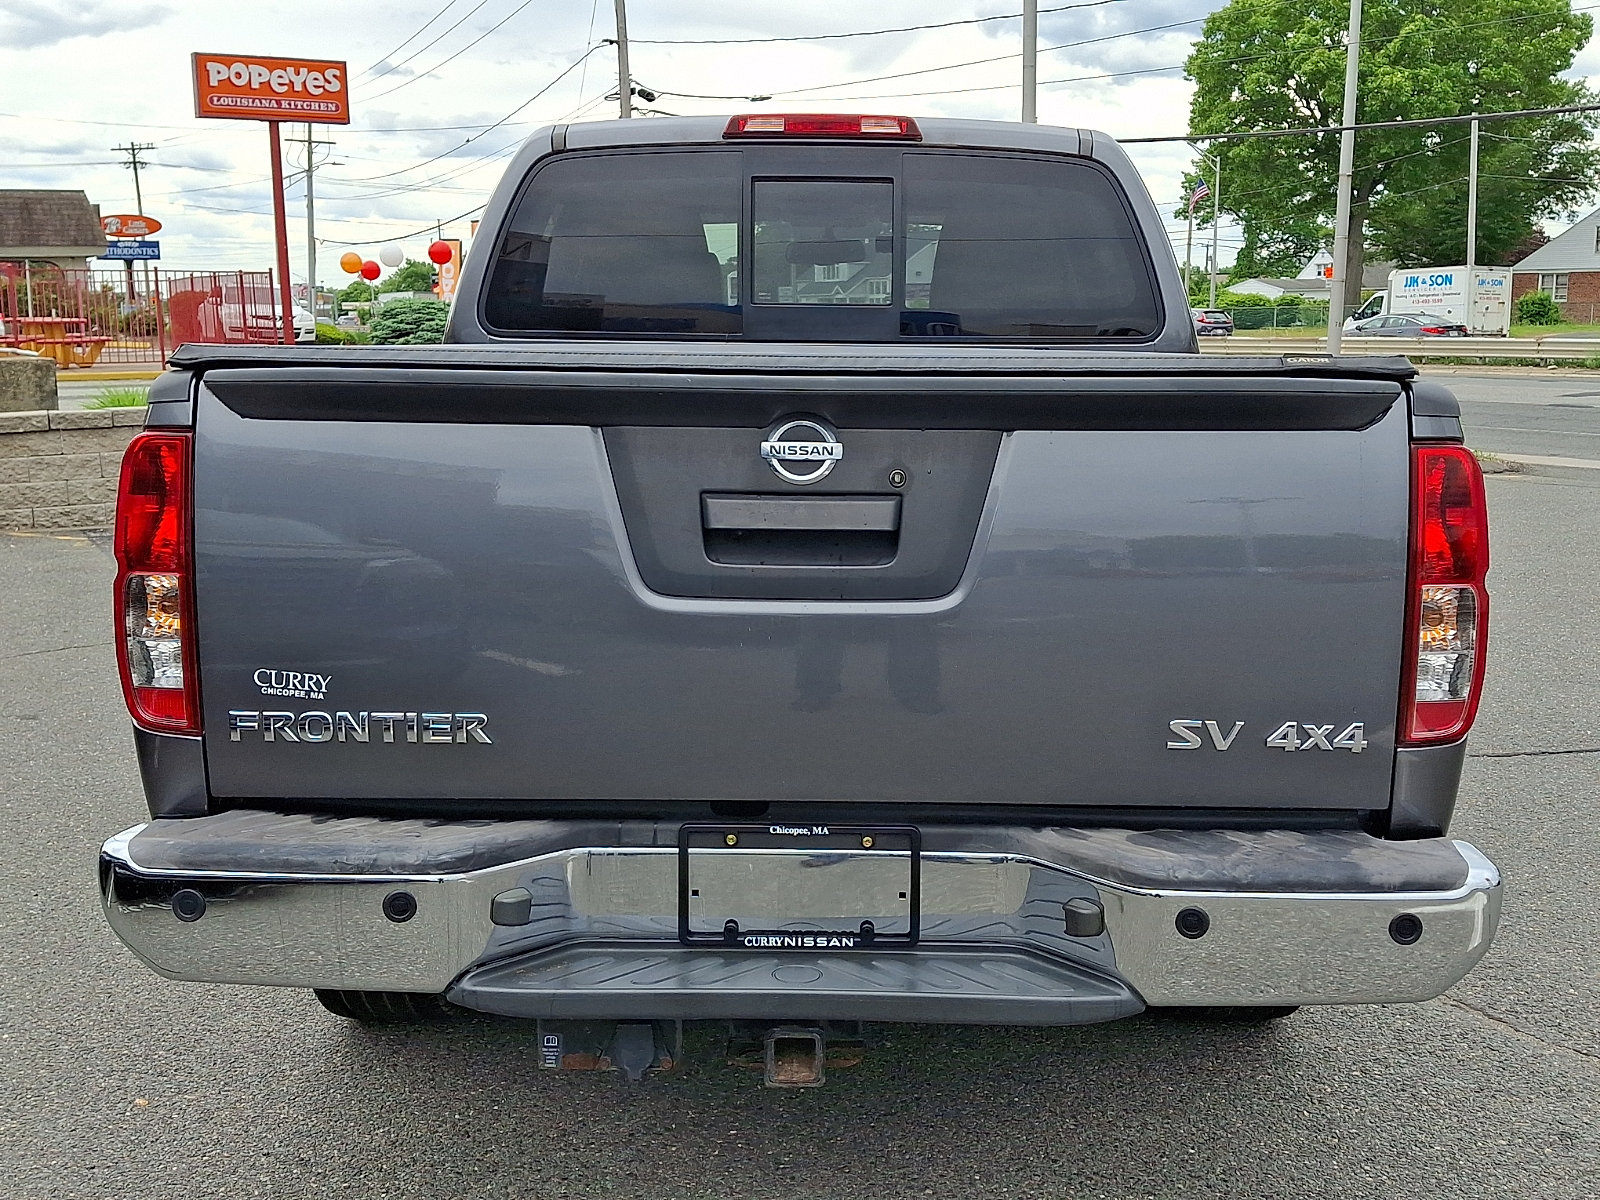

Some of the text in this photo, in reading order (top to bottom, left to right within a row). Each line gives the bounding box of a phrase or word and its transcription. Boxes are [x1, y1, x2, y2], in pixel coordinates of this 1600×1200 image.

[212, 96, 337, 112] LOUISIANA KITCHEN
[1404, 276, 1419, 288] JJK
[1429, 274, 1453, 287] SON
[769, 445, 834, 456] NISSAN
[253, 668, 332, 693] CURRY
[261, 687, 325, 700] CHICOPEE, MA
[228, 710, 493, 744] FRONTIER
[1166, 719, 1245, 751] SV
[769, 825, 830, 836] Chicopee, MA
